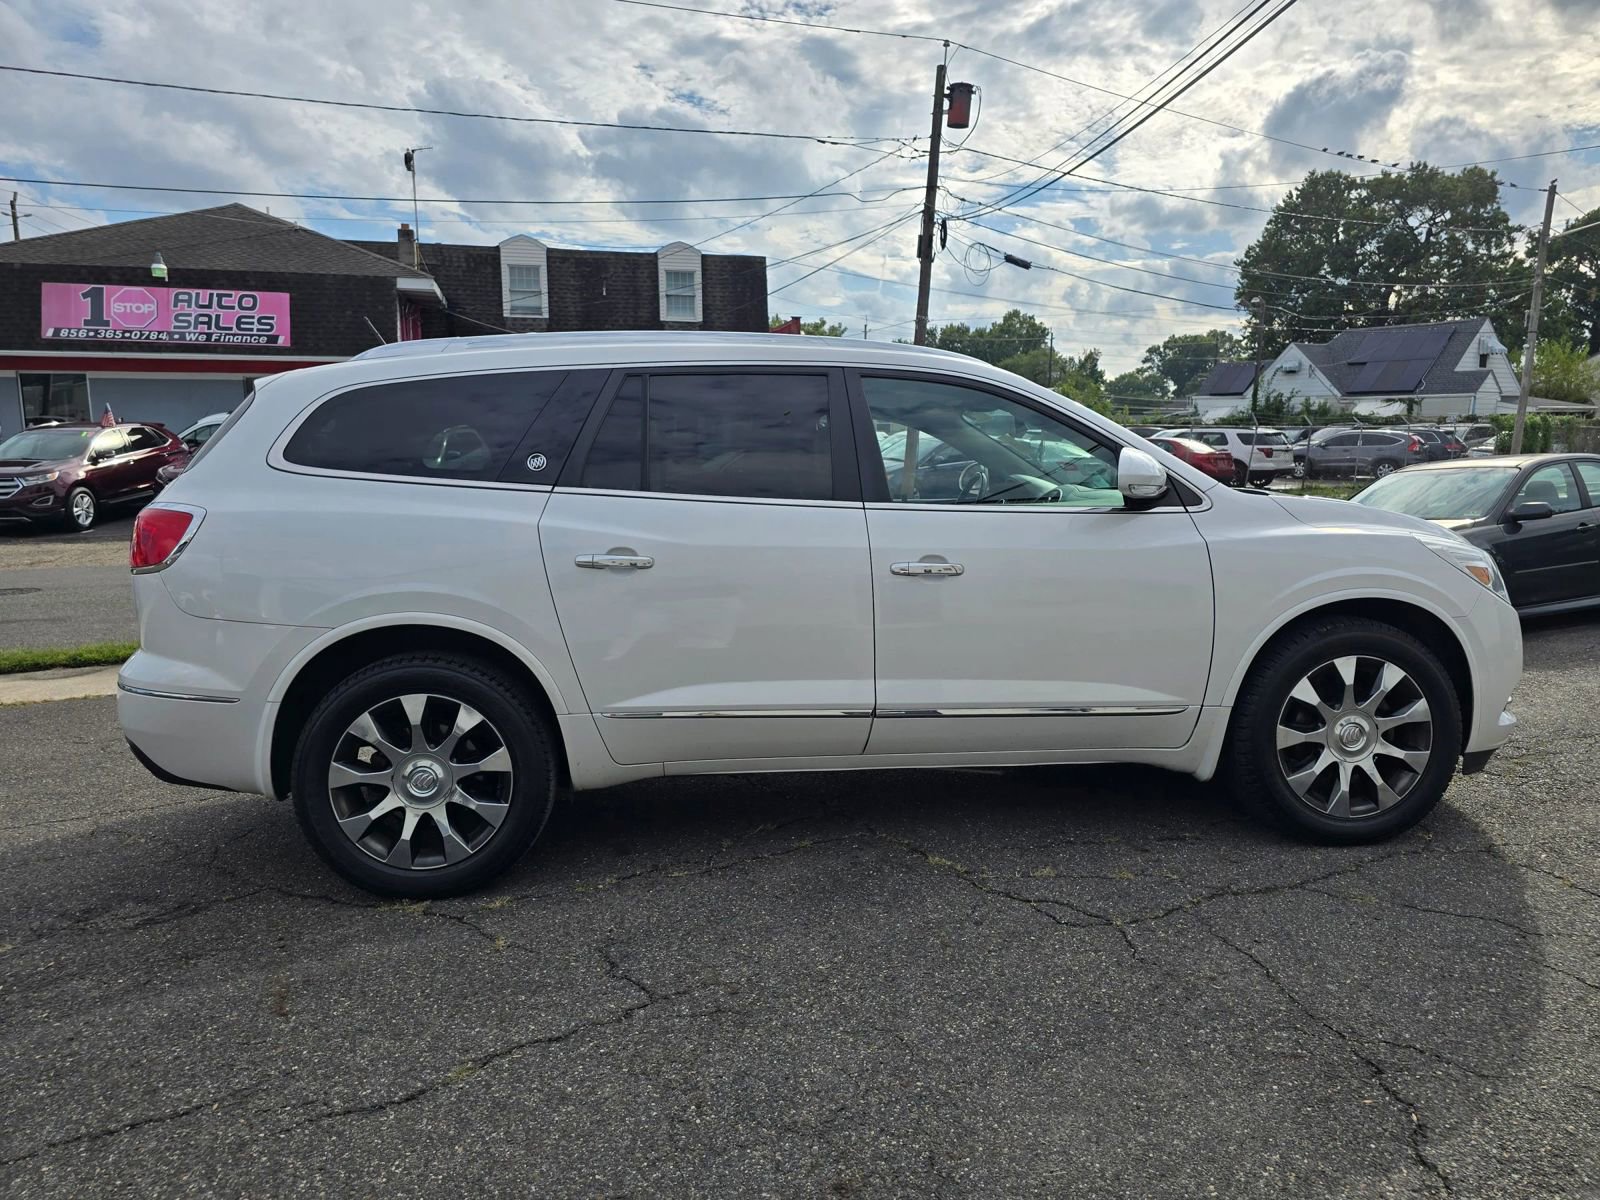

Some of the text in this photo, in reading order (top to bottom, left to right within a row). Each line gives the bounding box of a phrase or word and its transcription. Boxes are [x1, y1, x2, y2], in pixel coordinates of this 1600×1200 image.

[80, 286, 155, 328] 1 STOP
[171, 291, 259, 311] AUTO
[172, 312, 276, 334] SALES
[185, 332, 207, 342] We
[211, 333, 268, 344] Finance
